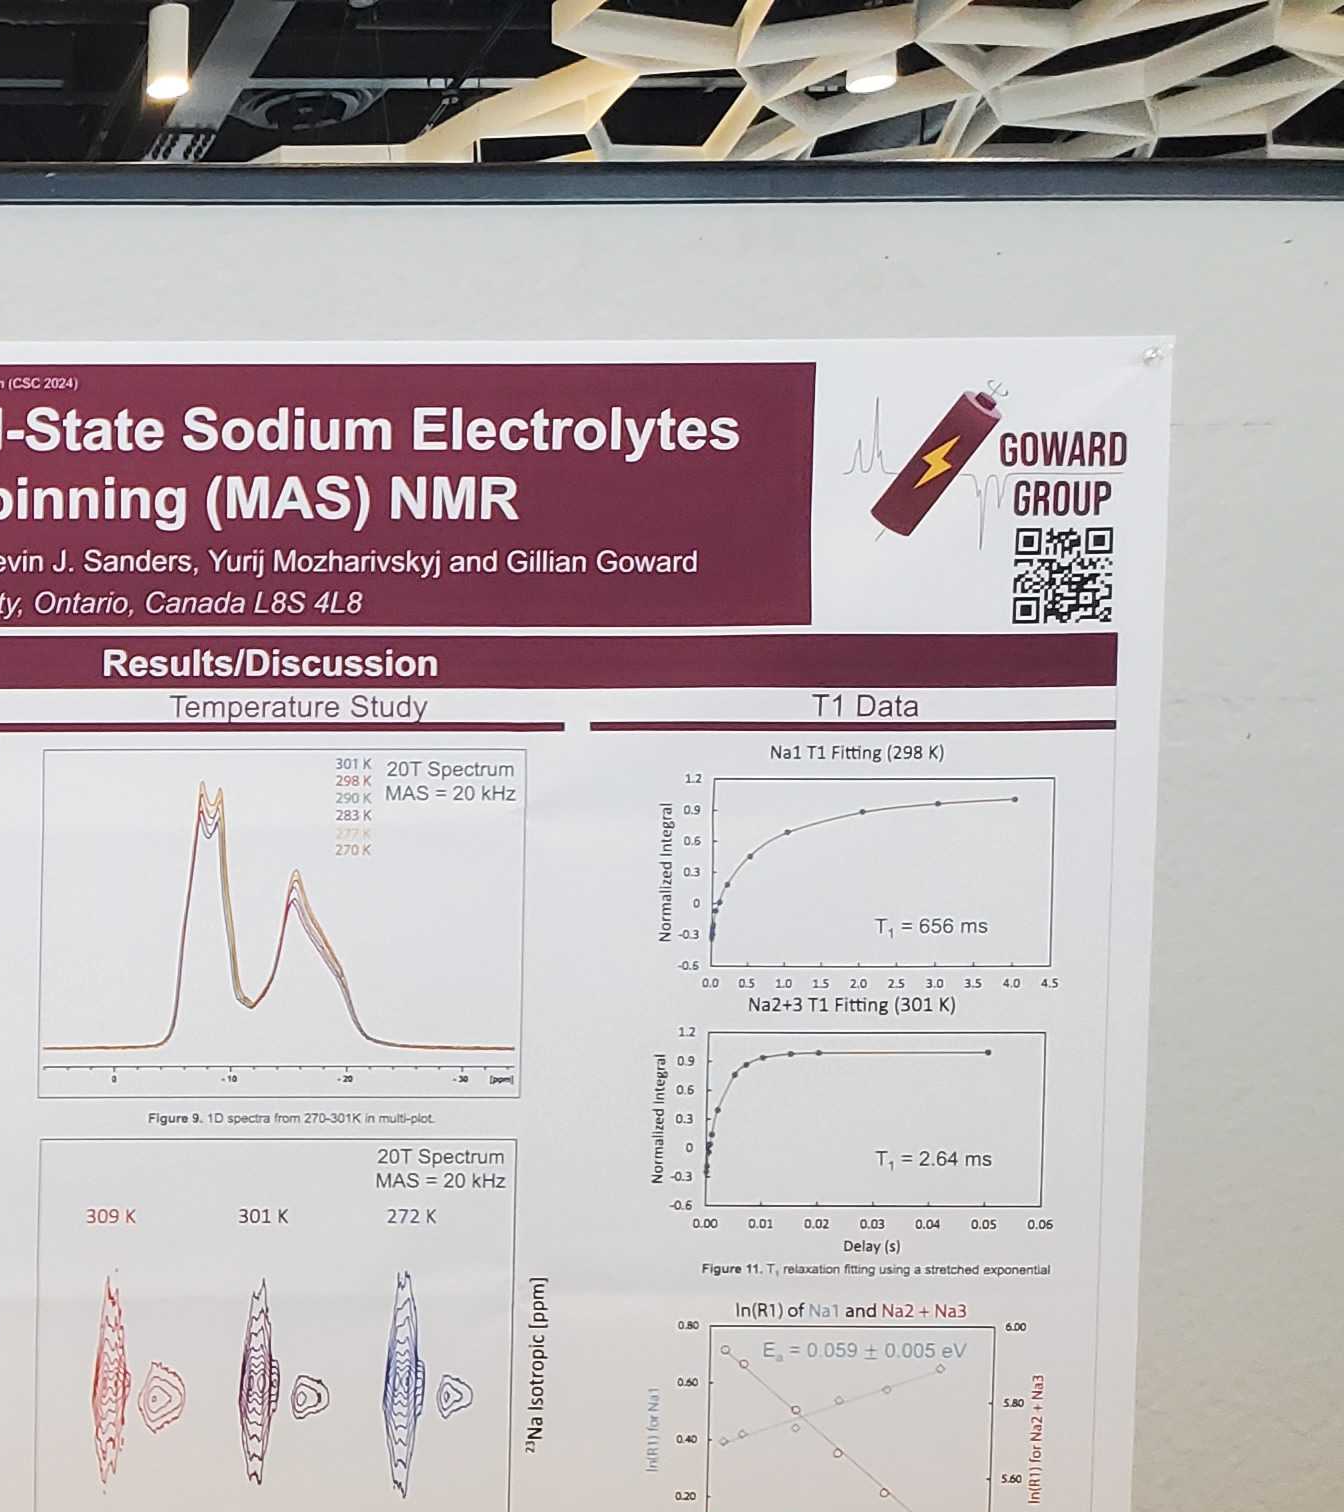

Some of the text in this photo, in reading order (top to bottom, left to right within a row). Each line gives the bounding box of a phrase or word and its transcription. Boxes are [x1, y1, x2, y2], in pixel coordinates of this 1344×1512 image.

[8, 377, 41, 390] (CSC
[43, 377, 78, 391] 2024)
[181, 406, 392, 452] Sodium
[413, 405, 740, 463] Electrolytes
[999, 431, 1127, 467] GOWARD
[206, 475, 371, 532] (MAS)
[390, 475, 519, 522] NMR
[1013, 480, 1112, 517] GROUP
[52, 549, 74, 573] J.
[83, 549, 199, 576] Sanders,
[208, 548, 265, 578] Yurij
[273, 548, 441, 579] Mozharivskyj
[449, 550, 498, 573] and
[506, 548, 587, 573] Gillian
[596, 549, 698, 574] Goward
[34, 590, 134, 618] Ontario,
[145, 590, 246, 615] Canada
[253, 591, 306, 614] L8S
[313, 591, 363, 614] 4L8
[103, 647, 438, 678] Results/Discussion
[169, 694, 428, 720] Temperature Study
[811, 693, 919, 718] T1 Data
[770, 743, 945, 763] Na1 T1 Fitting (298 K)
[658, 802, 676, 943] Normalized Integral
[148, 1111, 435, 1127] Figure 9. 1D spectra from 270-301K in multi-plot.
[86, 1208, 136, 1224] 309 K
[238, 1208, 289, 1224] 301 K
[387, 1208, 437, 1225] 272 K
